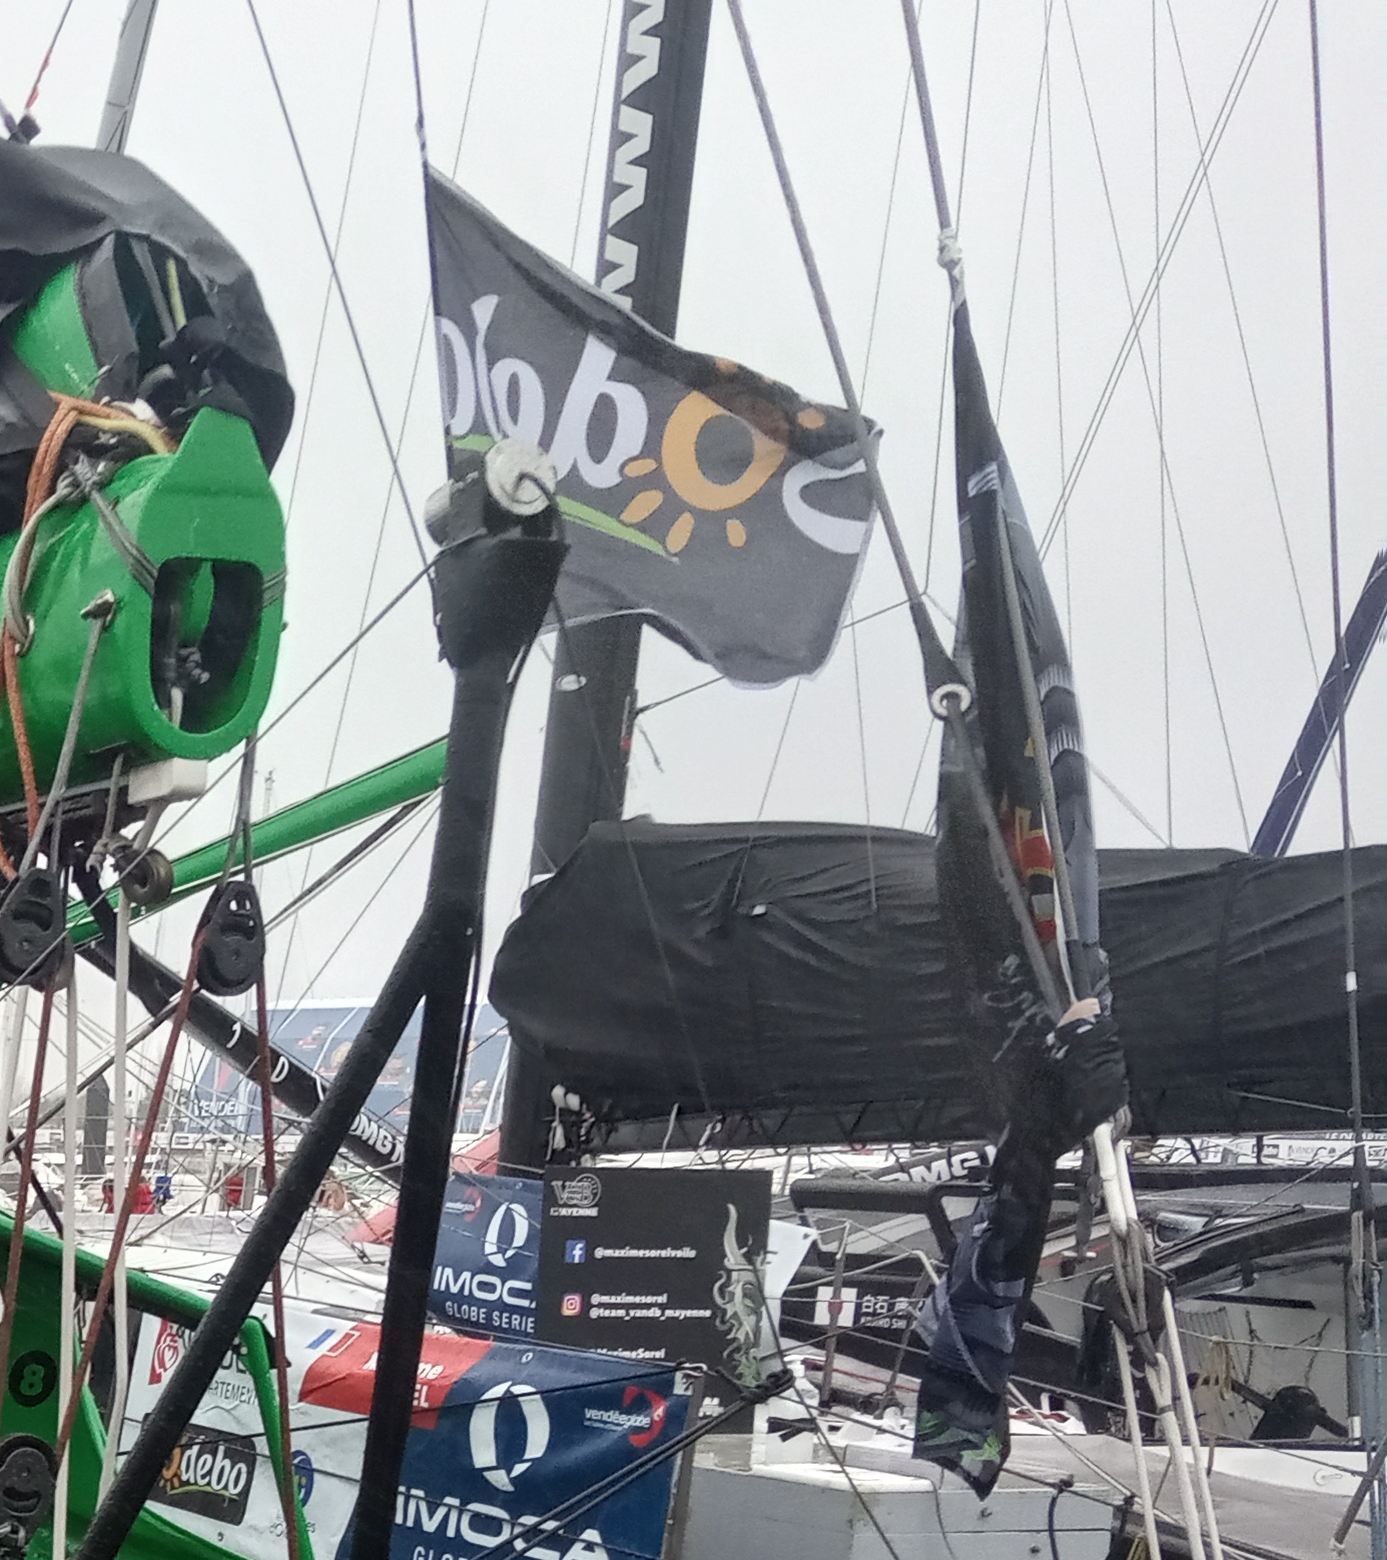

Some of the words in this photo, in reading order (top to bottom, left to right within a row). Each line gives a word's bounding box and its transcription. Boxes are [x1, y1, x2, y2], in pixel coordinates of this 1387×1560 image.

[432, 1264, 537, 1309] IMOC
[590, 1292, 669, 1306] @maximesorel
[444, 1300, 487, 1325] GLOBE
[491, 1305, 536, 1334] SERIE
[589, 1307, 713, 1321] @team_vandb_mayenne
[18, 1362, 46, 1394] 8
